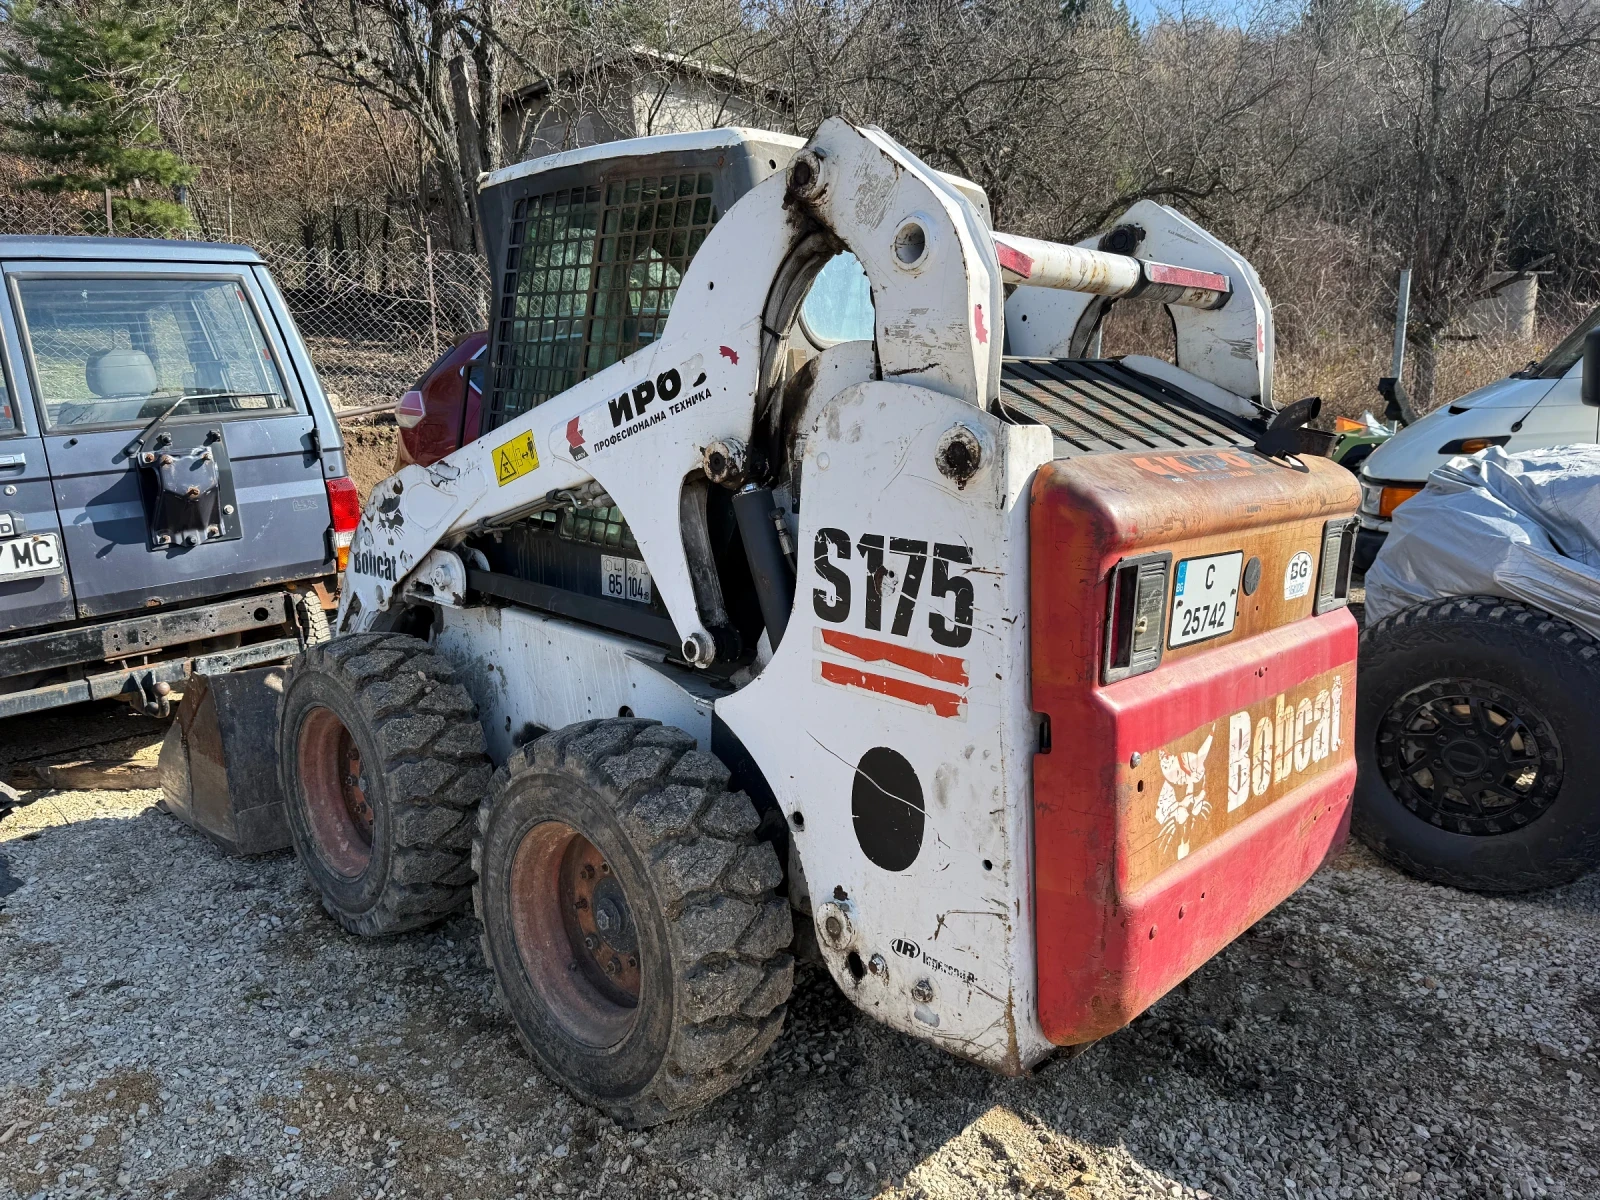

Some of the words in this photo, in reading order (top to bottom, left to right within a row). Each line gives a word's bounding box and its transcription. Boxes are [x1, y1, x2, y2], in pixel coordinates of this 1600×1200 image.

[594, 410, 667, 453] ПРОФЕСИОНАЛНА
[669, 388, 712, 416] ТЕХНИКА
[354, 549, 397, 583] Bobcat
[1205, 564, 1216, 590] C
[609, 574, 622, 595] 85
[628, 577, 643, 599] 104
[812, 527, 974, 648] S175
[1181, 601, 1226, 637] 25742
[1227, 675, 1343, 813] Bobcat
[896, 939, 916, 958] IR
